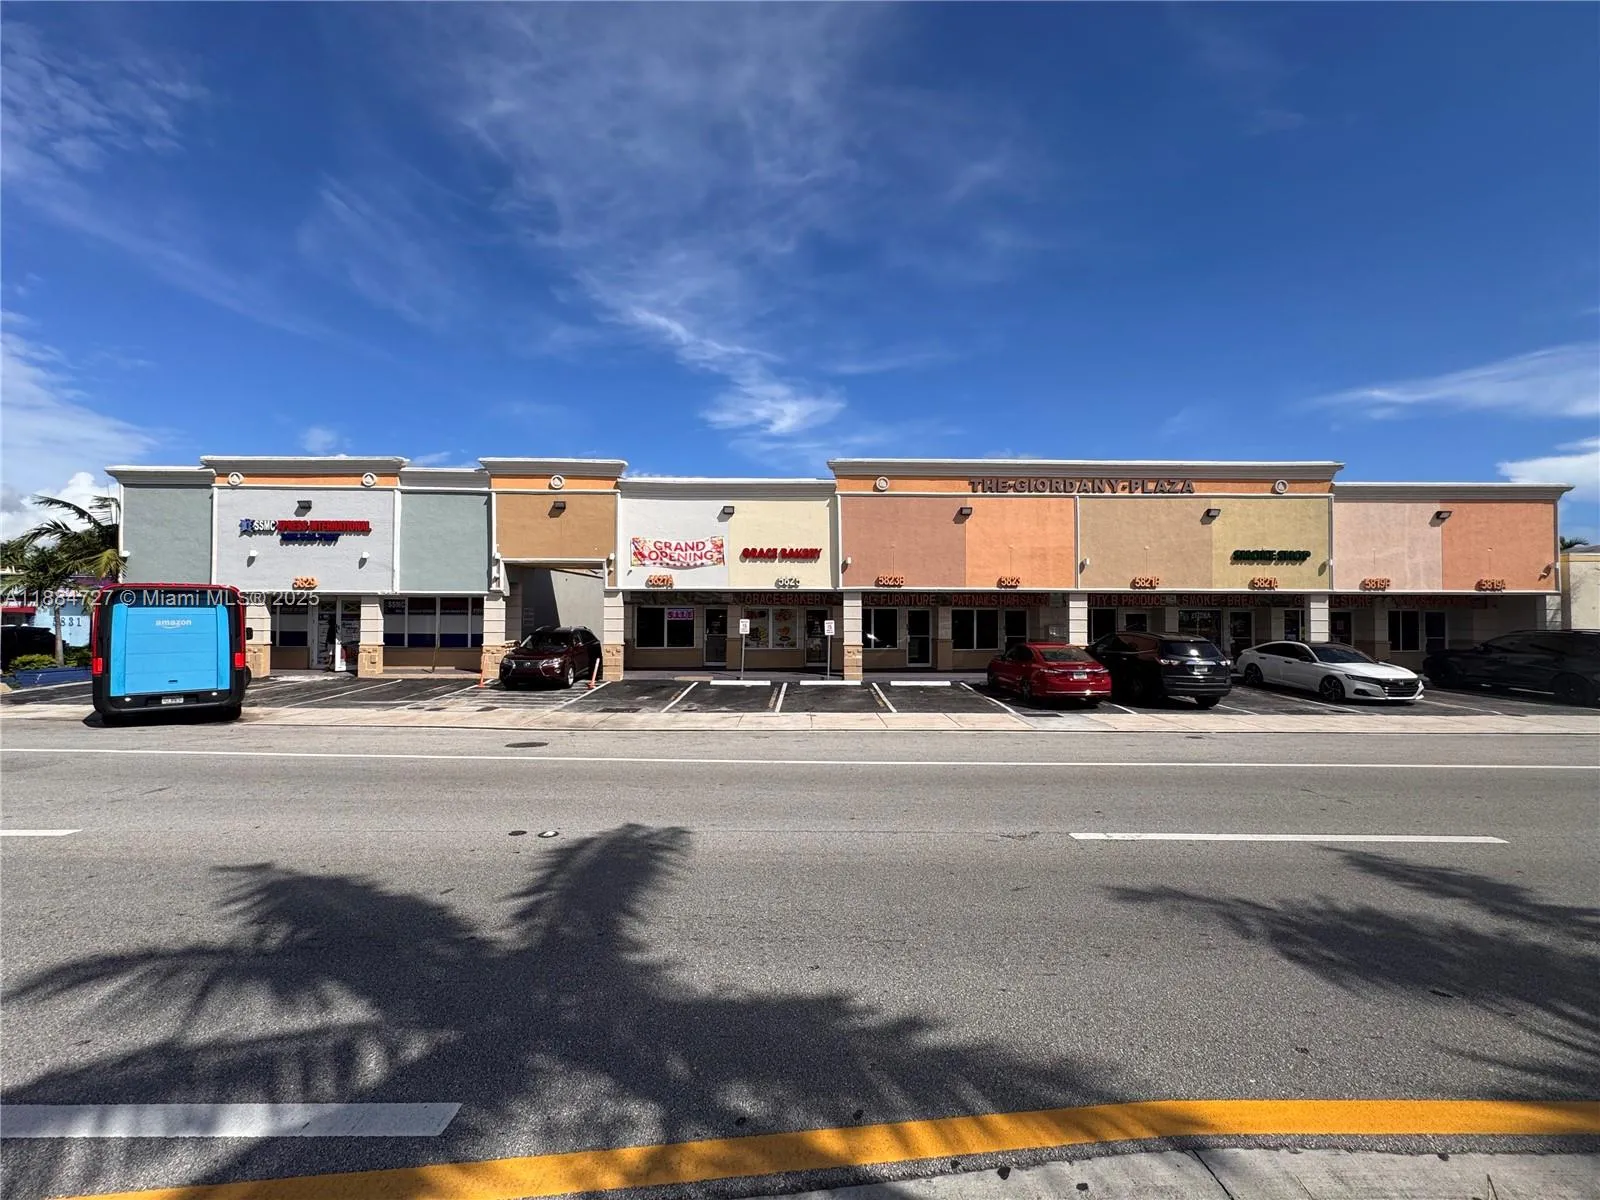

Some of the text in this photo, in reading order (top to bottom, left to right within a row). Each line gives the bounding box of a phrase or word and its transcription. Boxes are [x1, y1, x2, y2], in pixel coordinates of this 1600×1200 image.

[1128, 479, 1195, 494] PLAZA
[653, 540, 706, 552] GRAND
[648, 550, 714, 561] OPENING
[780, 548, 822, 560] BAKERY
[1232, 550, 1311, 561] SMOKE SHOP
[786, 592, 828, 604] BAKERY
[880, 594, 936, 606] FURNITURE
[1182, 595, 1218, 606] SMOKE
[156, 618, 192, 628] amazon
